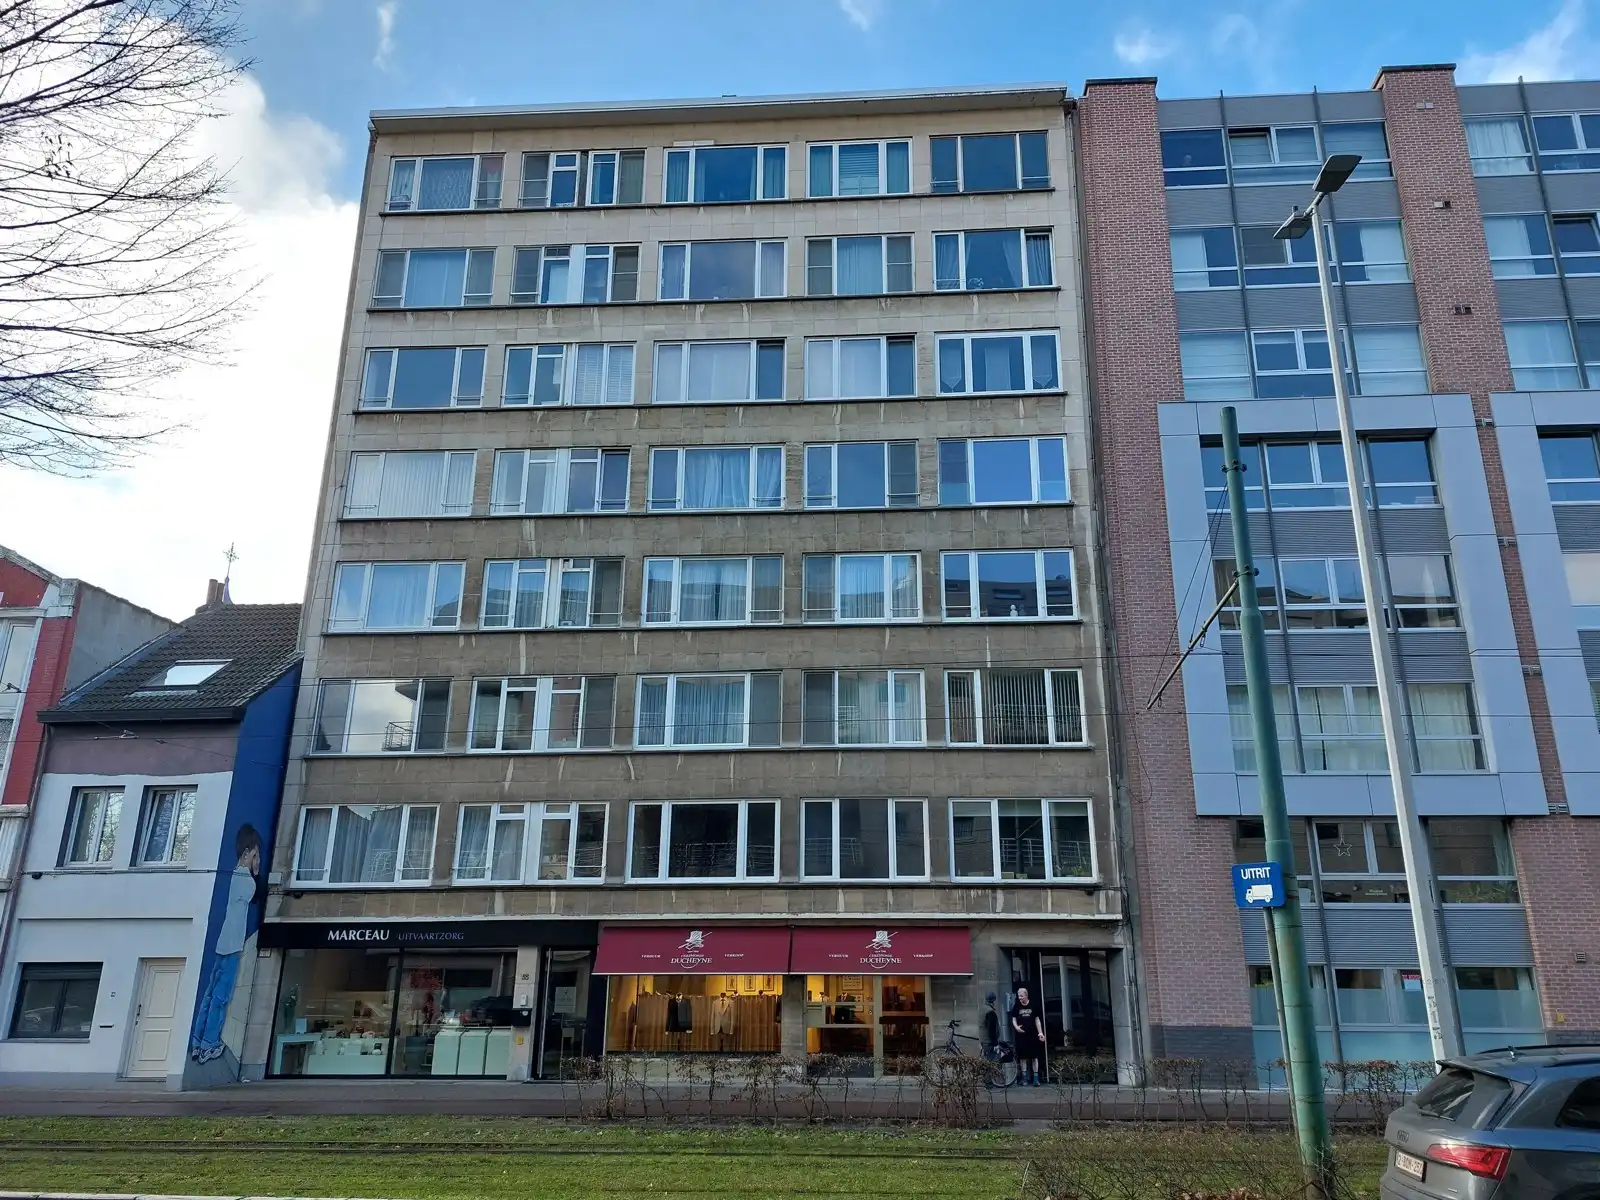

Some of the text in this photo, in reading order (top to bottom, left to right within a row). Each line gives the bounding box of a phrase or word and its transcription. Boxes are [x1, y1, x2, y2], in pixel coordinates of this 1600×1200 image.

[1240, 866, 1271, 880] UITRIT
[327, 929, 465, 941] MARCEAU UITVAARTZORG
